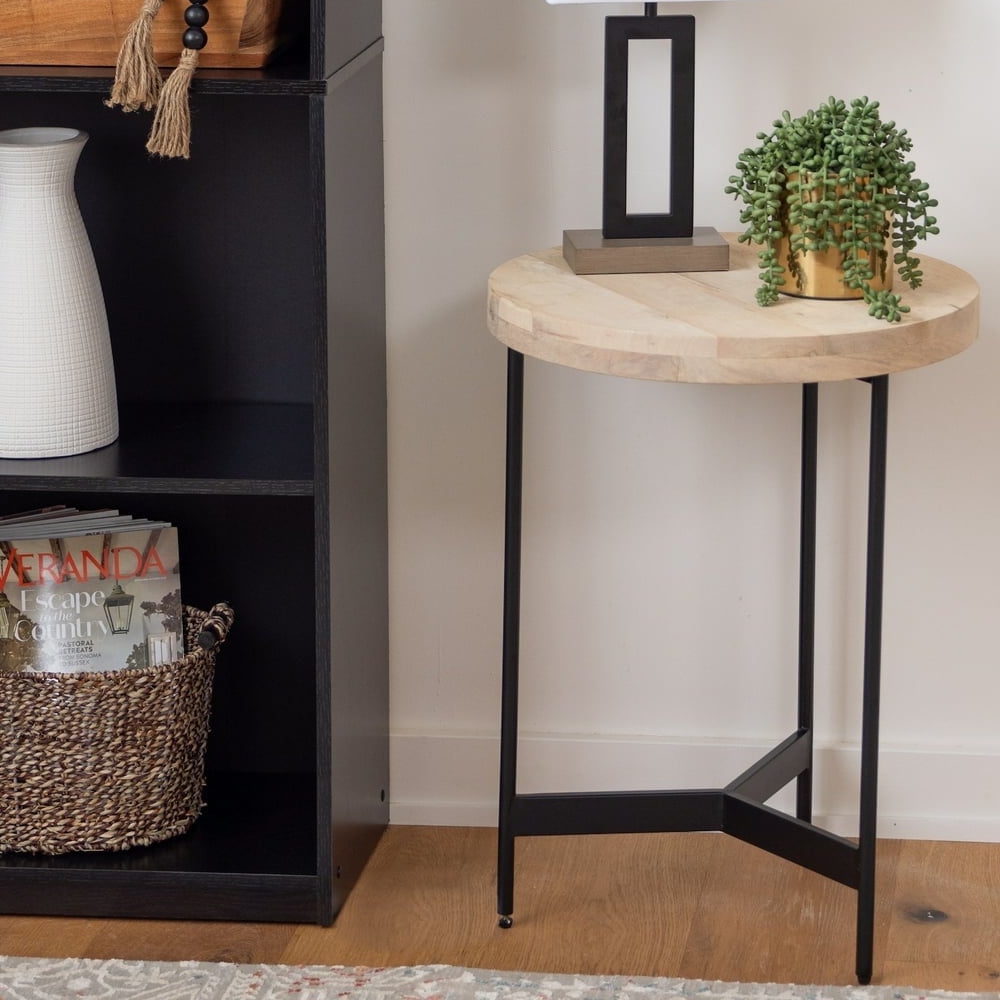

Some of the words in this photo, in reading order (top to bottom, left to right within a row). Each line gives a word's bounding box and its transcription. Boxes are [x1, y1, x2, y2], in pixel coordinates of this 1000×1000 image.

[21, 589, 105, 614] Escape
[54, 610, 73, 621] the
[14, 617, 108, 642] Country
